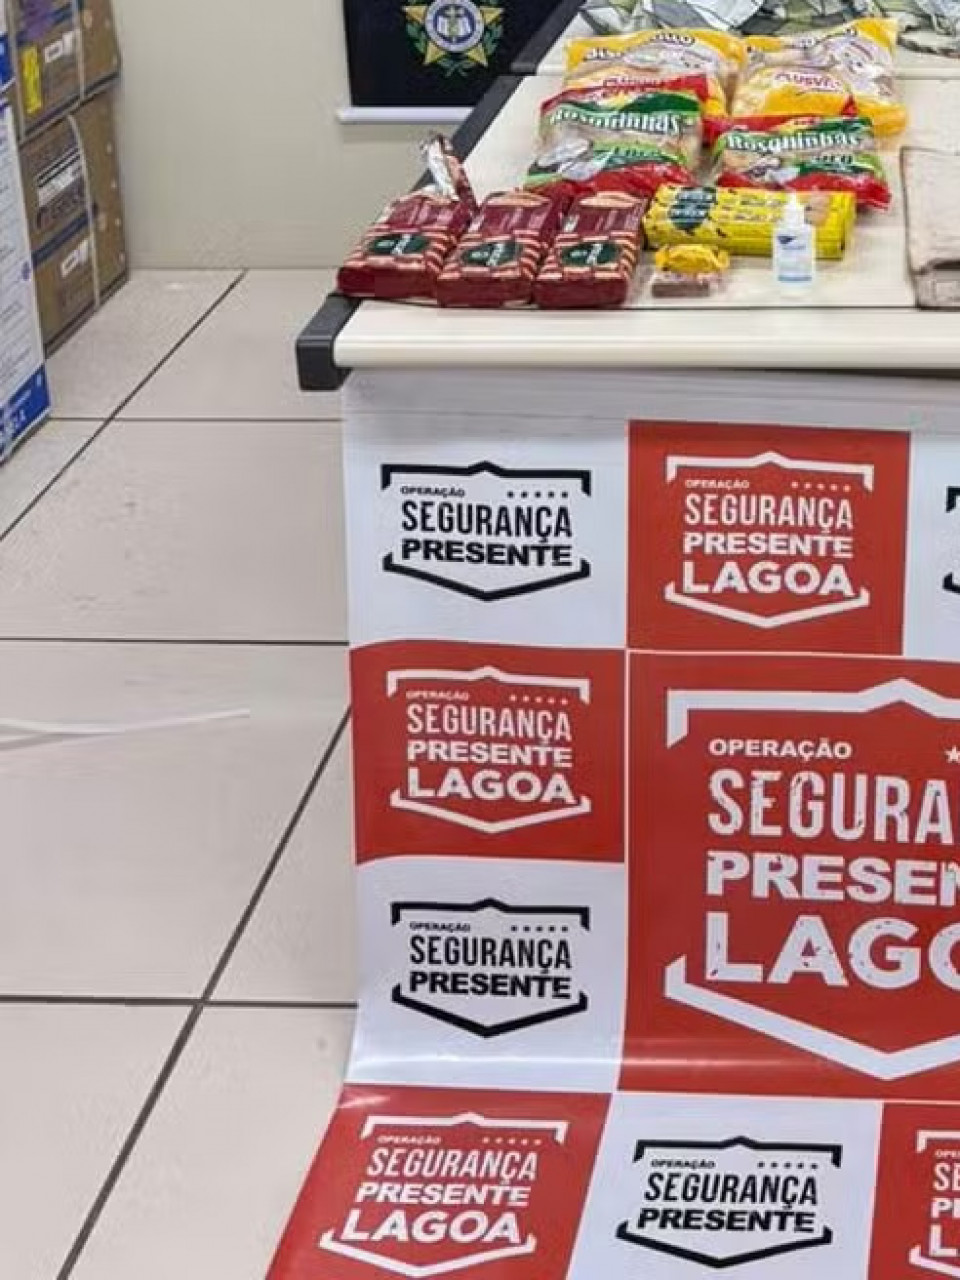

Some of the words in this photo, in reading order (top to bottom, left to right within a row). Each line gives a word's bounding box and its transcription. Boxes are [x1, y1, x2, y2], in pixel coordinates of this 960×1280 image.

[401, 501, 572, 543] SEGURANÇA
[684, 494, 853, 535] SEGURANÇA
[401, 540, 572, 567] PRESENTE
[683, 532, 853, 558] PRESENTE
[682, 562, 855, 597] LAGOA
[407, 704, 572, 746] SEGURANÇA
[407, 741, 573, 768] PRESENTE
[708, 737, 852, 761] OPERAÇÃO
[407, 768, 576, 803] LAGOA
[409, 935, 572, 976] SEGURANÇA
[409, 971, 571, 1000] PRESENTE
[367, 1148, 539, 1187] SEGURANÇA
[355, 1182, 531, 1207] PRESENTE
[644, 1172, 818, 1211] SEGURANÇA
[340, 1209, 521, 1244] LAGOA
[637, 1208, 816, 1233] PRESENTE
